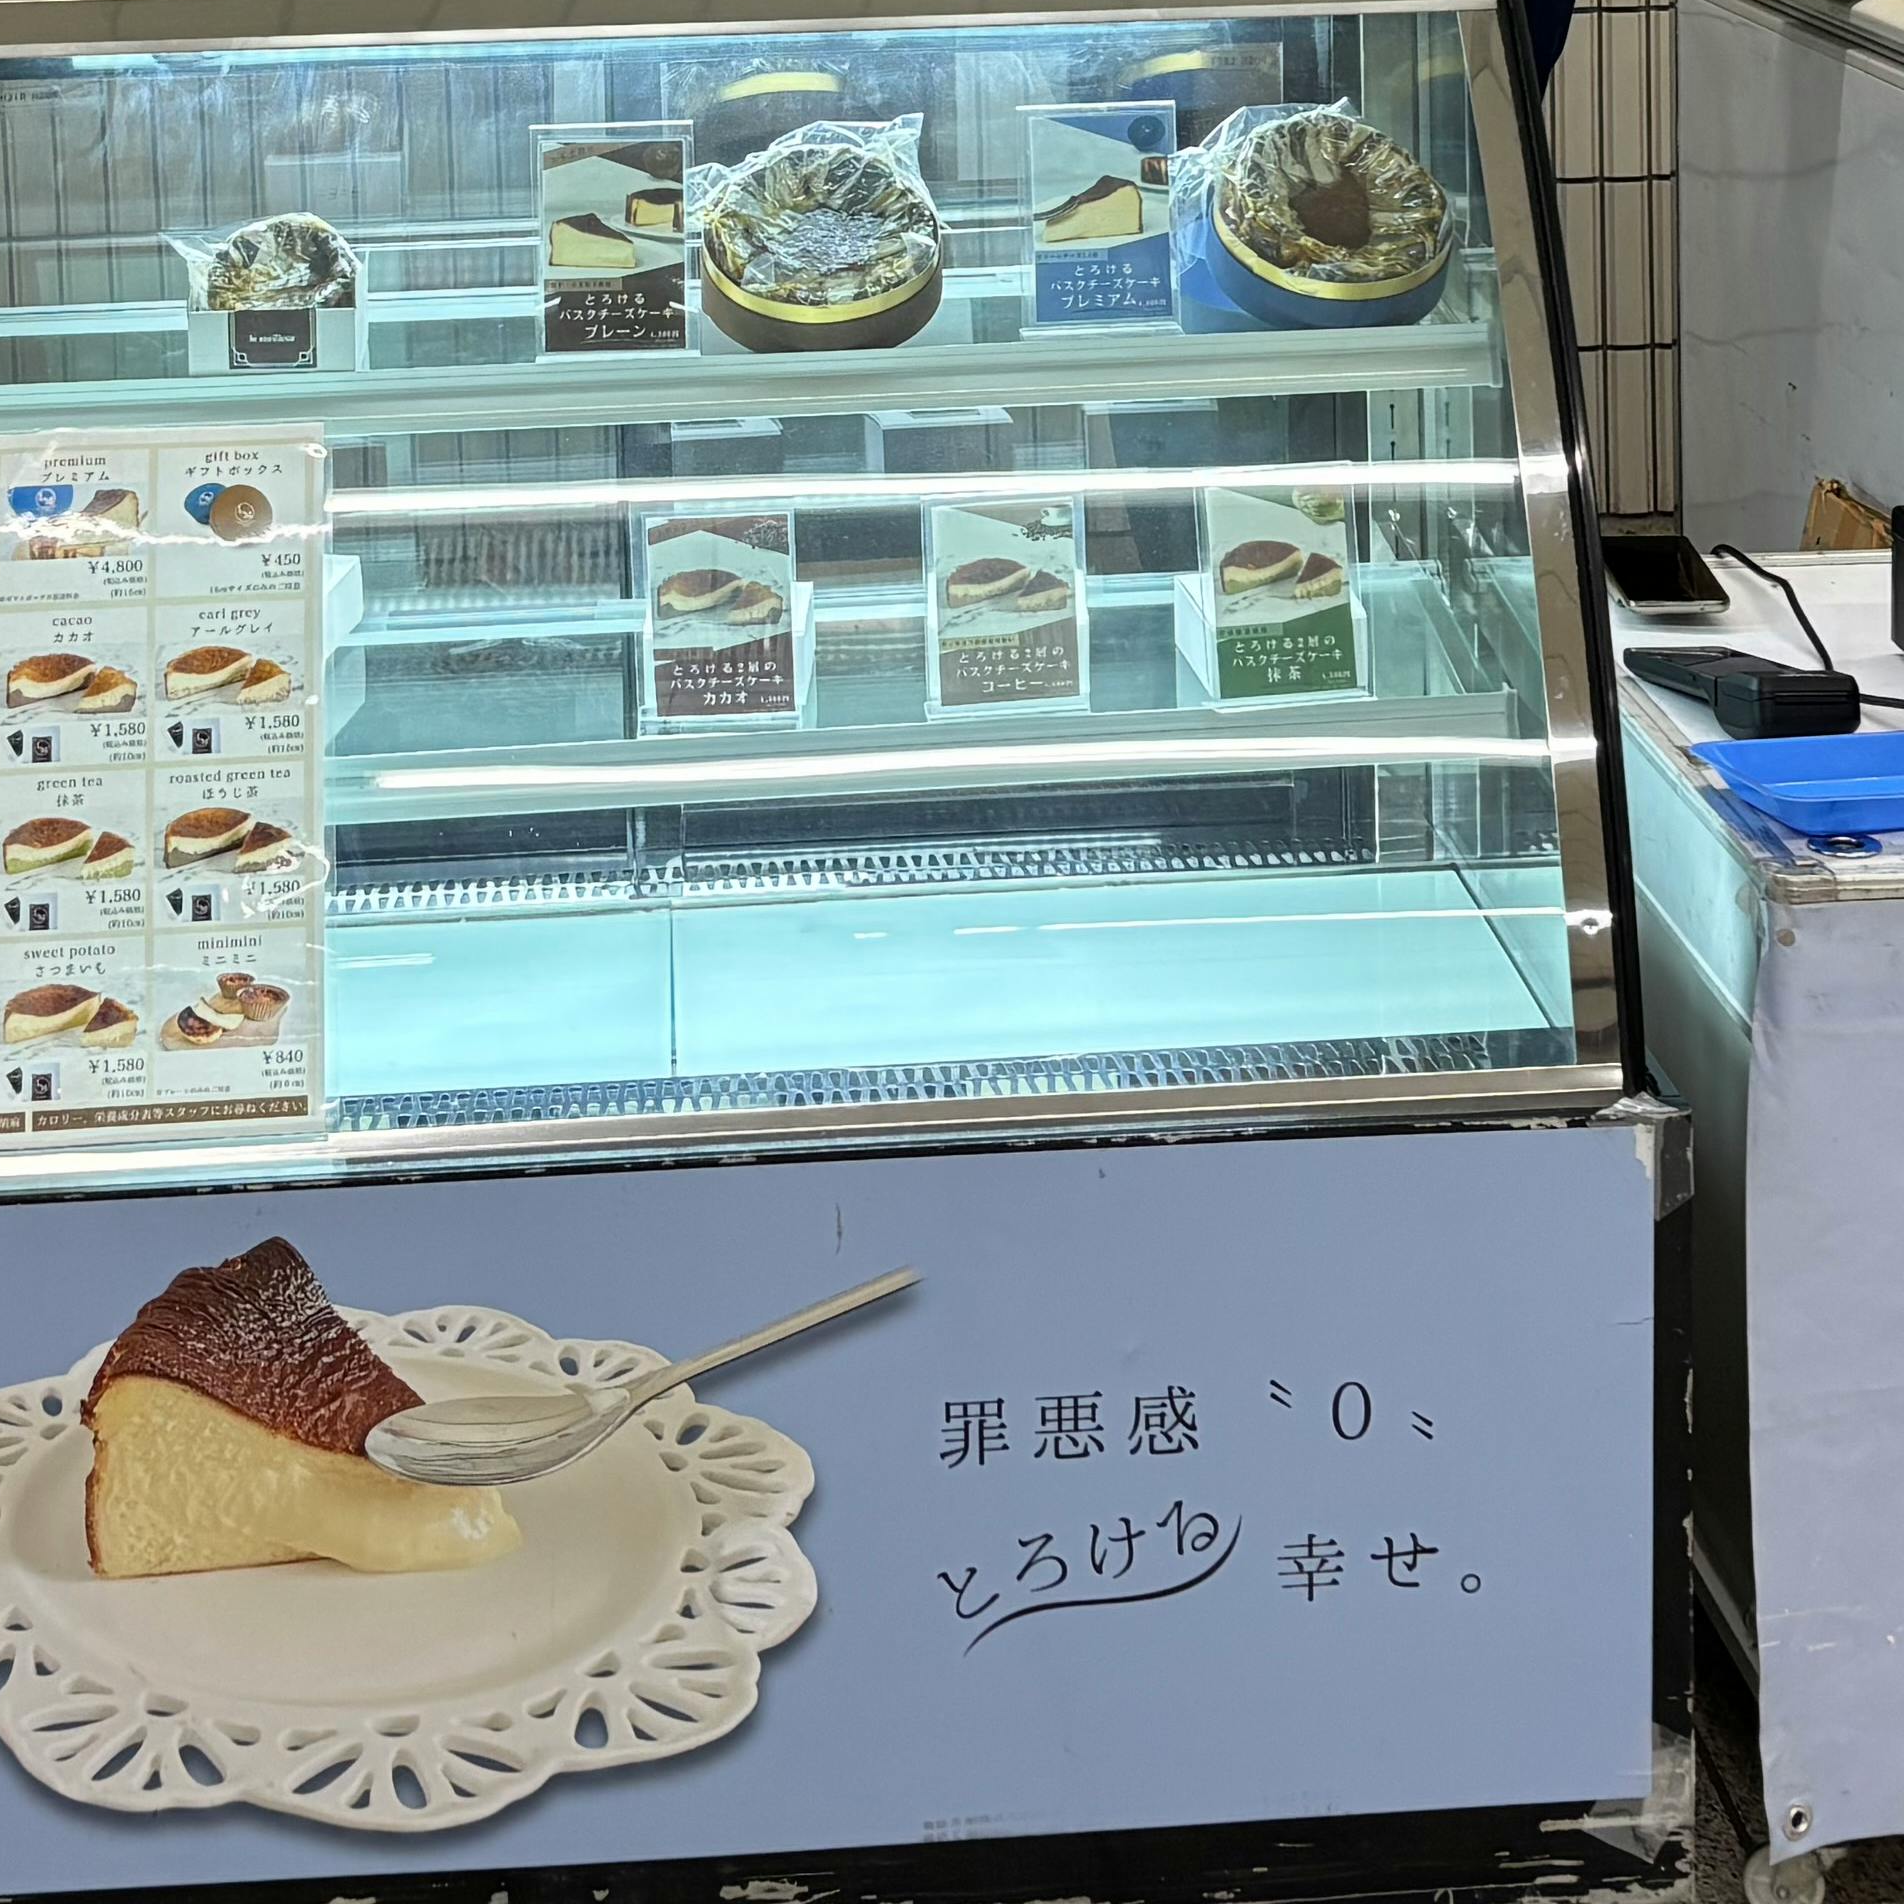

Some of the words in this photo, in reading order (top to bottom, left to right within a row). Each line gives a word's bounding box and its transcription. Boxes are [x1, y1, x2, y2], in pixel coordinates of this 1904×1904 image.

[1075, 263, 1133, 277] とろける
[1050, 277, 1161, 291] バスクチーズケーキ
[585, 293, 645, 306] とろける
[1061, 293, 1136, 309] プレミアム
[560, 307, 675, 321] バスクチーズケーキ
[585, 324, 647, 339] プレーン
[44, 455, 106, 469] premium
[205, 451, 229, 463] gift
[234, 450, 259, 461] box
[41, 471, 110, 483] プレミアム
[185, 464, 283, 478] ギフトボックス
[261, 553, 301, 567] ¥450
[52, 616, 93, 627] cacao
[230, 608, 261, 621] grey
[191, 623, 273, 637] アールグレイ
[53, 631, 94, 644] カカオ
[1233, 649, 1342, 667] バスクチーズケーキ
[956, 660, 1070, 678] バスクチーズケーキ
[670, 675, 784, 689] バスクチーズケーキ
[982, 678, 1043, 693] コーヒー
[704, 691, 748, 706] カカオ
[37, 778, 77, 791] green
[82, 776, 104, 787] tea
[169, 771, 221, 784] roasted
[226, 771, 265, 783] green
[270, 769, 291, 778] tea
[198, 936, 263, 950] minimini
[24, 947, 66, 960] sweet
[69, 945, 116, 958] potato
[202, 954, 257, 966] ミニミニ
[35, 961, 106, 978] さつまいも
[263, 1049, 303, 1065] ¥840
[938, 1385, 1201, 1468] 罪悪感
[936, 1500, 1220, 1620] とろける
[1276, 1531, 1482, 1603] 幸せ。
